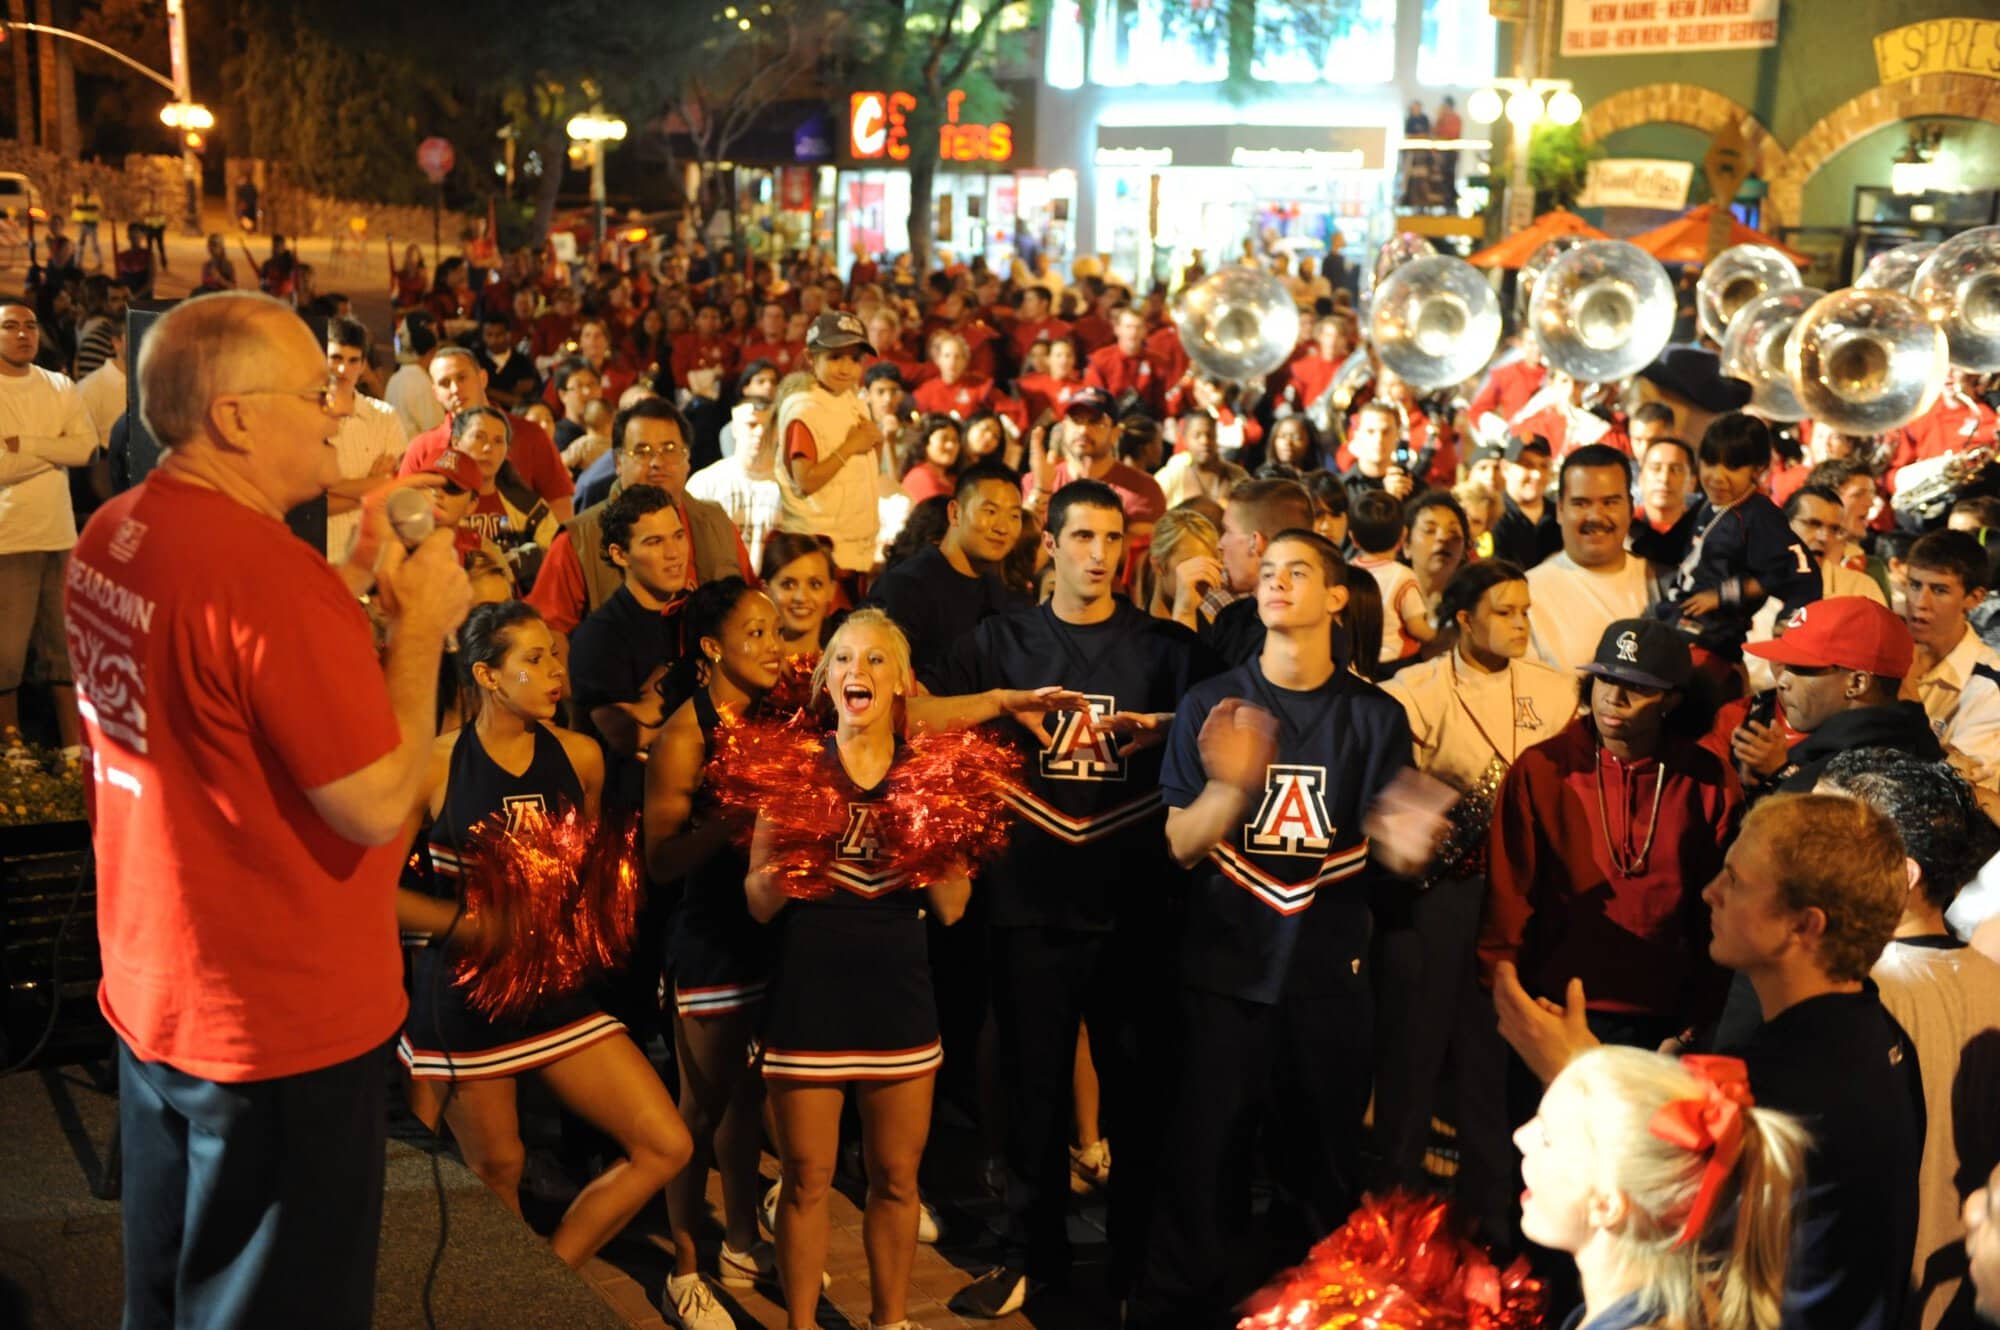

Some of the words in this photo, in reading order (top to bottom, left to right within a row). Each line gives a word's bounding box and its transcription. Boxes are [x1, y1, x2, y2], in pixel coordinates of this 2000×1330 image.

[1668, 1, 1696, 18] NEW
[1040, 694, 1127, 781] A
[1515, 696, 1543, 730] A
[1244, 764, 1336, 858] A
